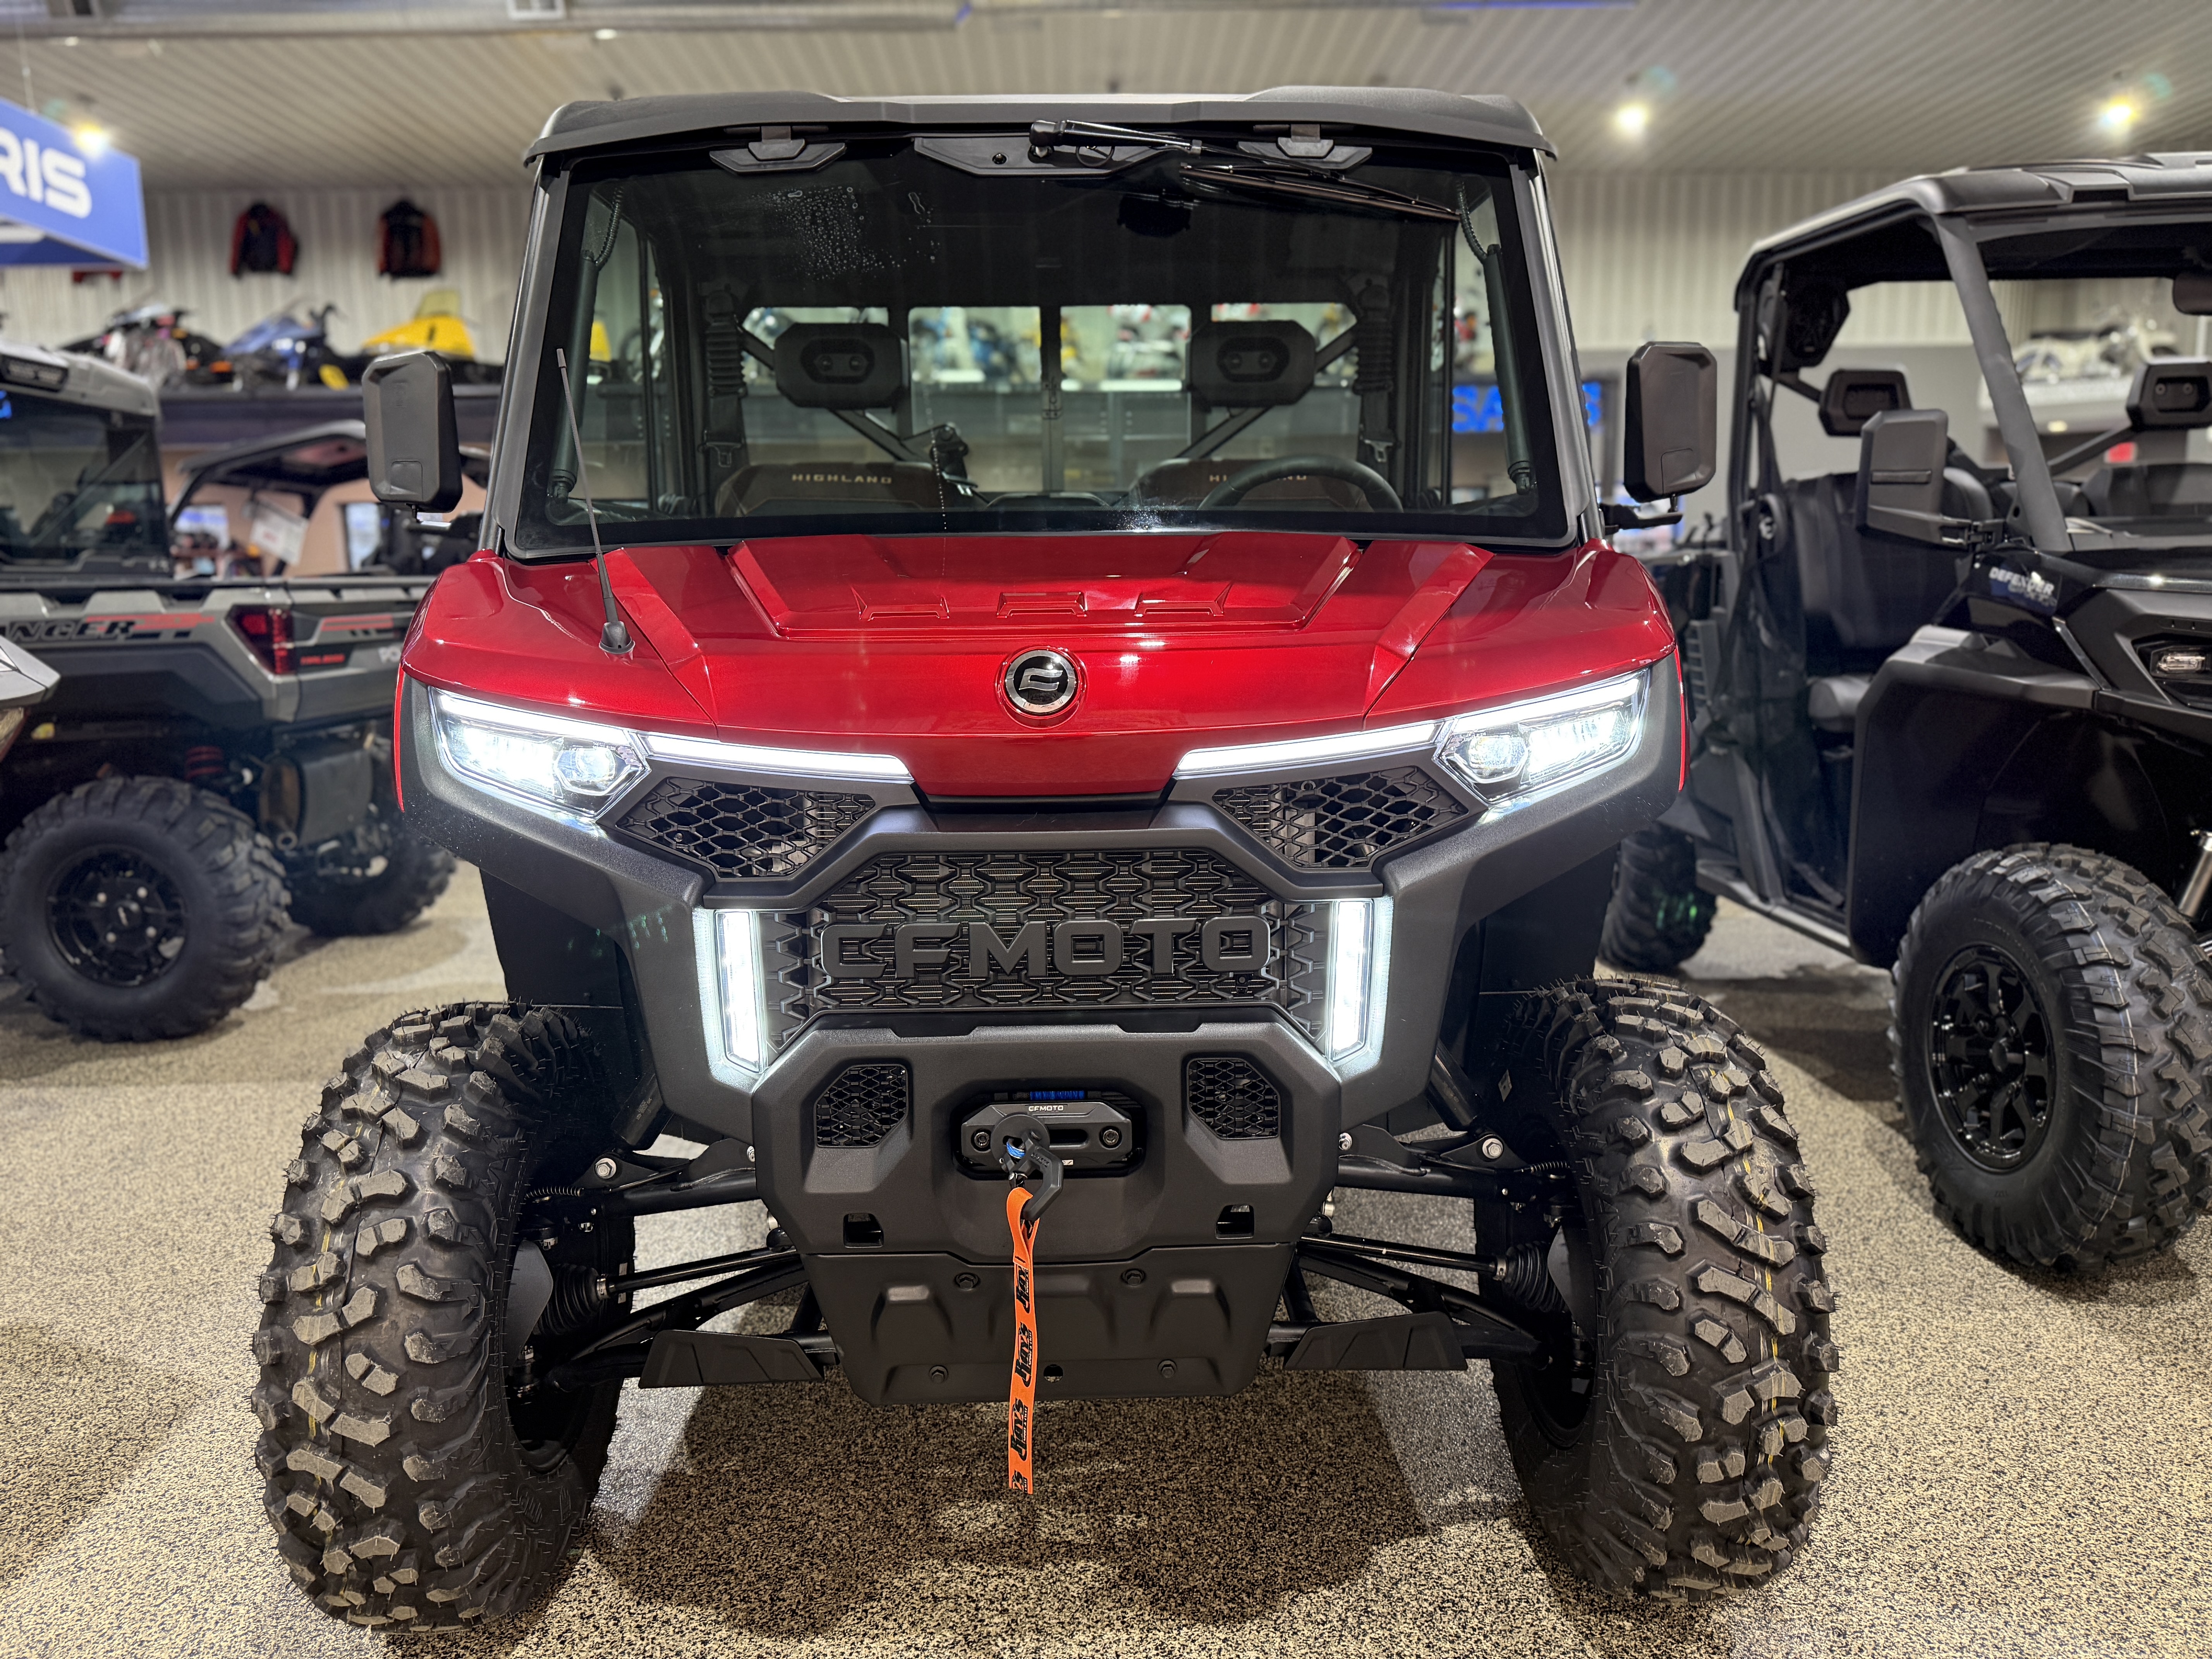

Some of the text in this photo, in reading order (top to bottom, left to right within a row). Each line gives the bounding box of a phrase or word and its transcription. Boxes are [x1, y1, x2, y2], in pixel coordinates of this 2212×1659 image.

[792, 474, 892, 484] HIGHLAND
[1989, 567, 2054, 595] DEFENDER
[0, 619, 136, 642] NGER
[821, 915, 1271, 978] CFMOTO
